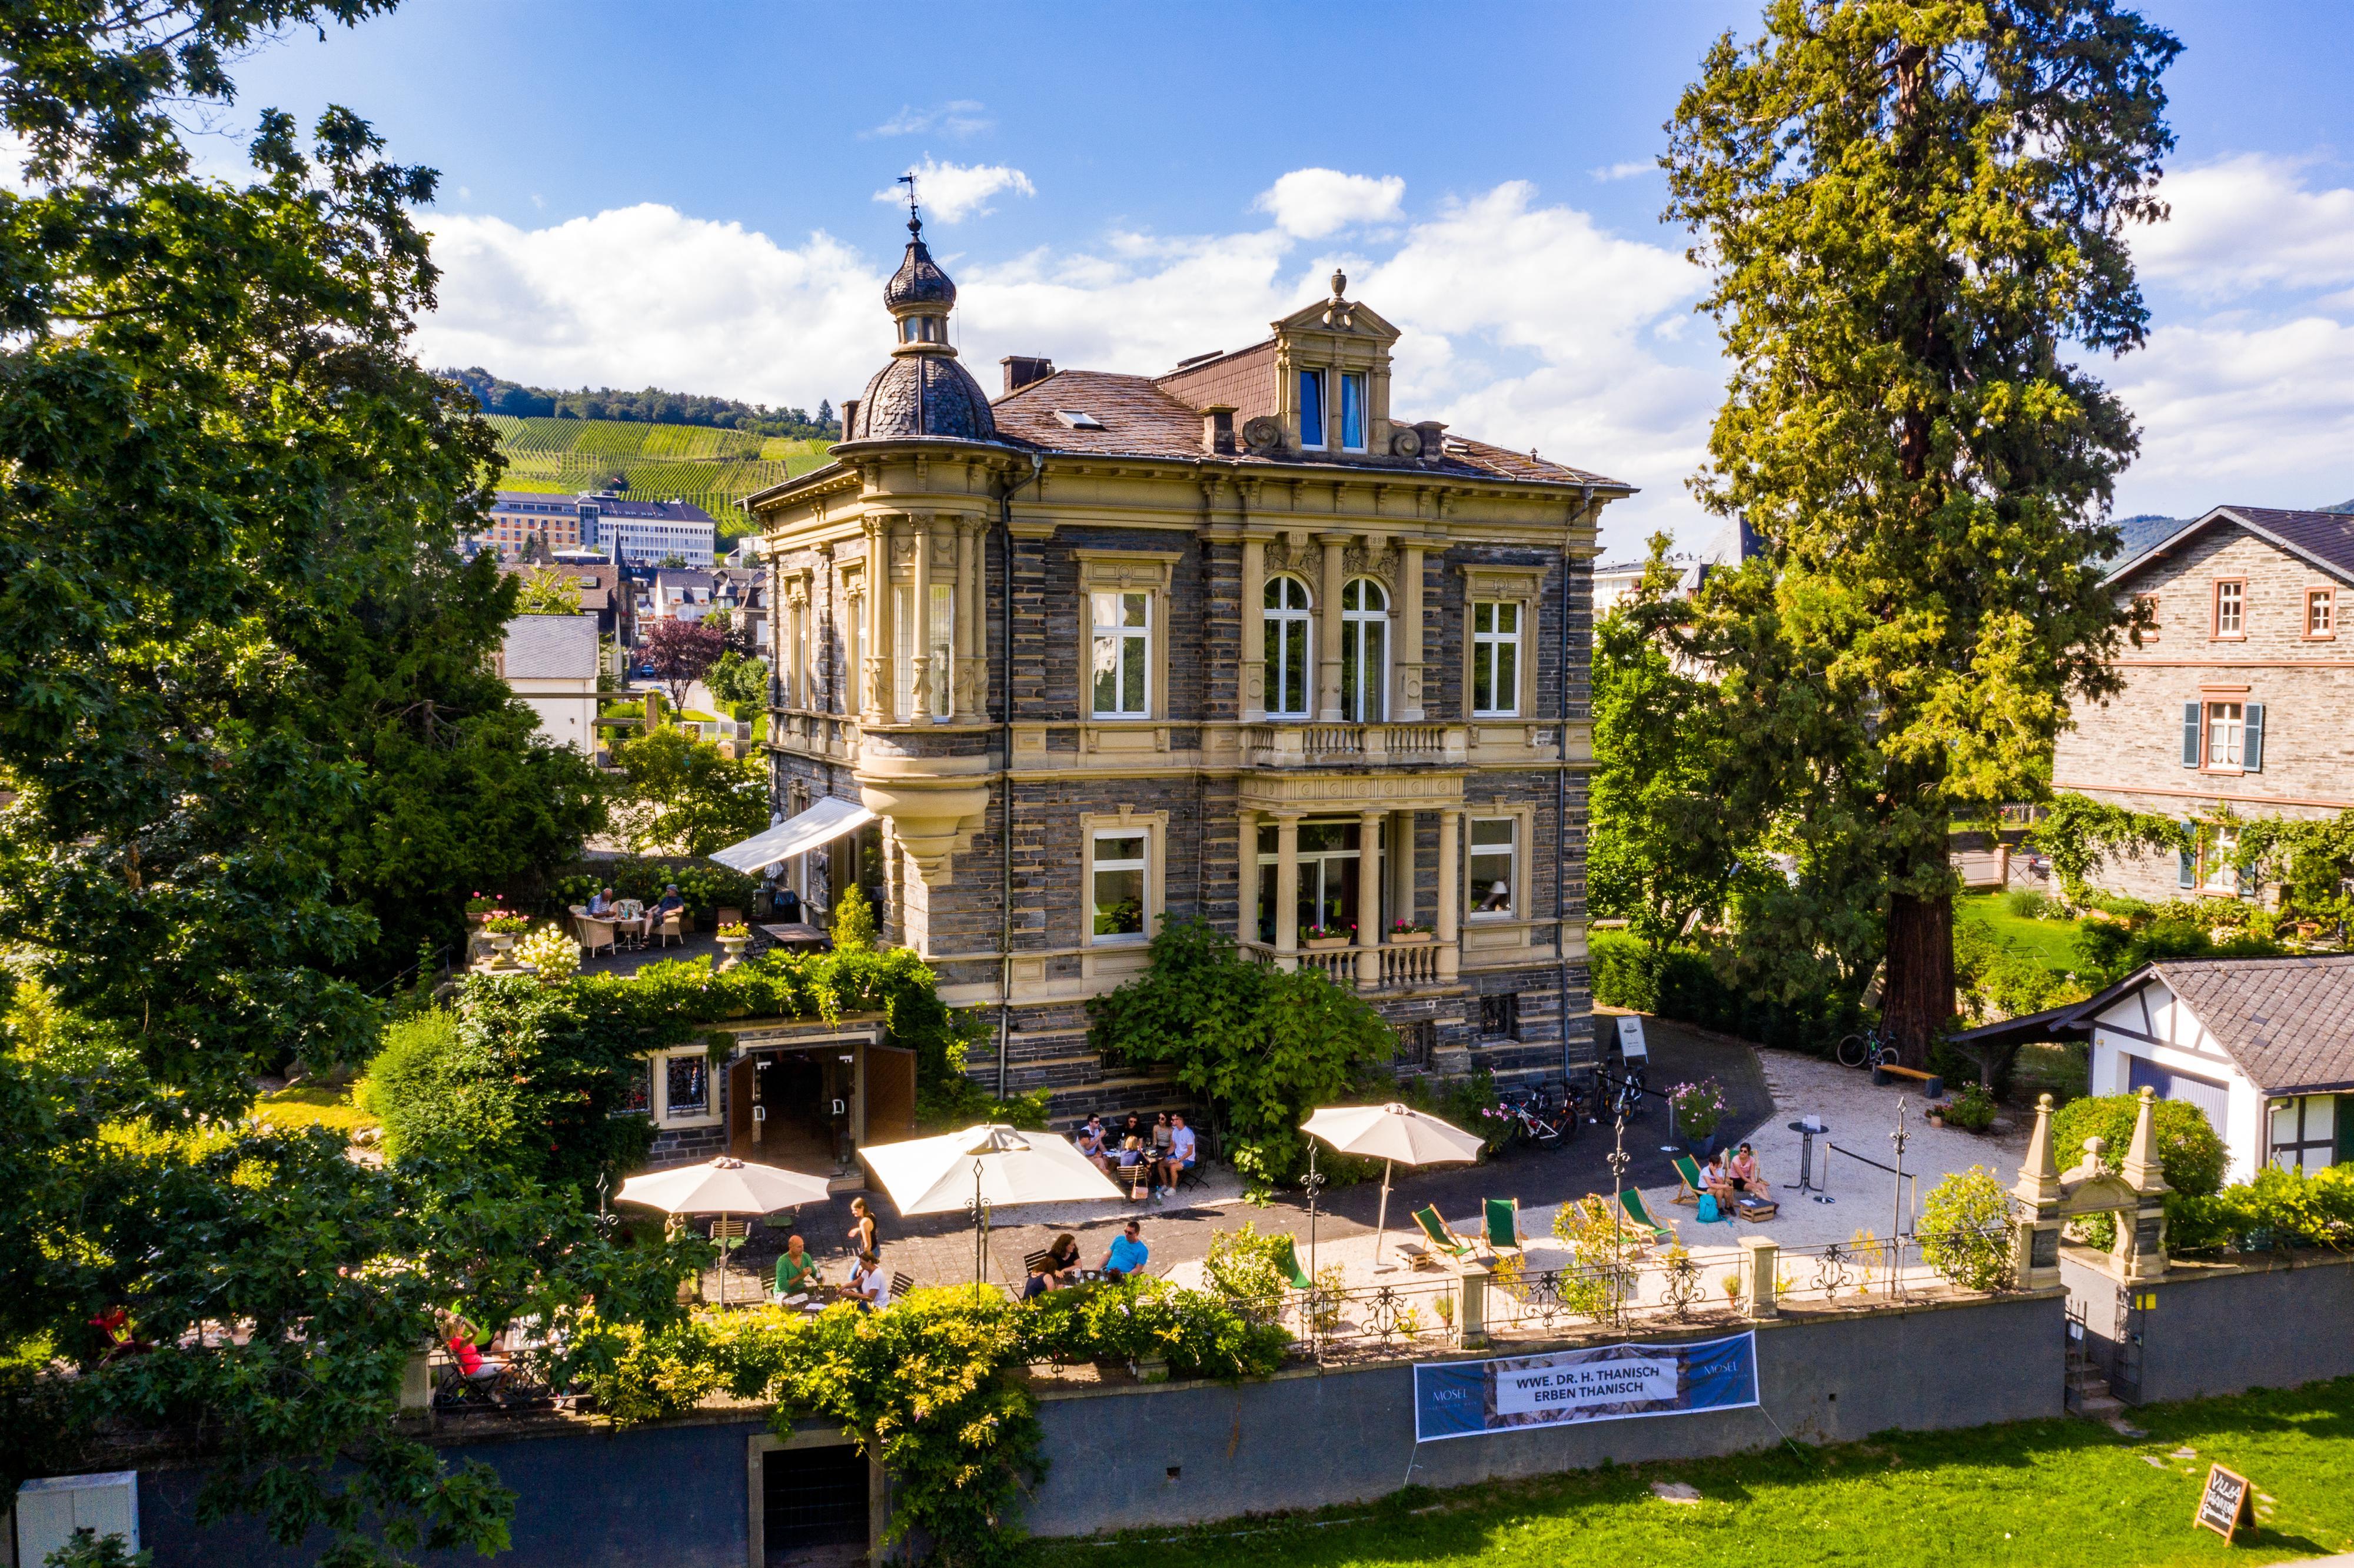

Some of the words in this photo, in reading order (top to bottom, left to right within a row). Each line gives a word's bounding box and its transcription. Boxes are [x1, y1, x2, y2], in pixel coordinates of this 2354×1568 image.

[1369, 536, 1386, 546] 1884
[1704, 1361, 1739, 1375] MOSEL
[1516, 1375, 1554, 1389] WWE.
[1556, 1374, 1578, 1386] DR.
[1581, 1371, 1594, 1383] H.
[1596, 1367, 1660, 1381] THANISCH
[1433, 1389, 1468, 1401] MOSEL
[1534, 1388, 1576, 1402] ERBEN
[1579, 1382, 1644, 1397] THANISCH
